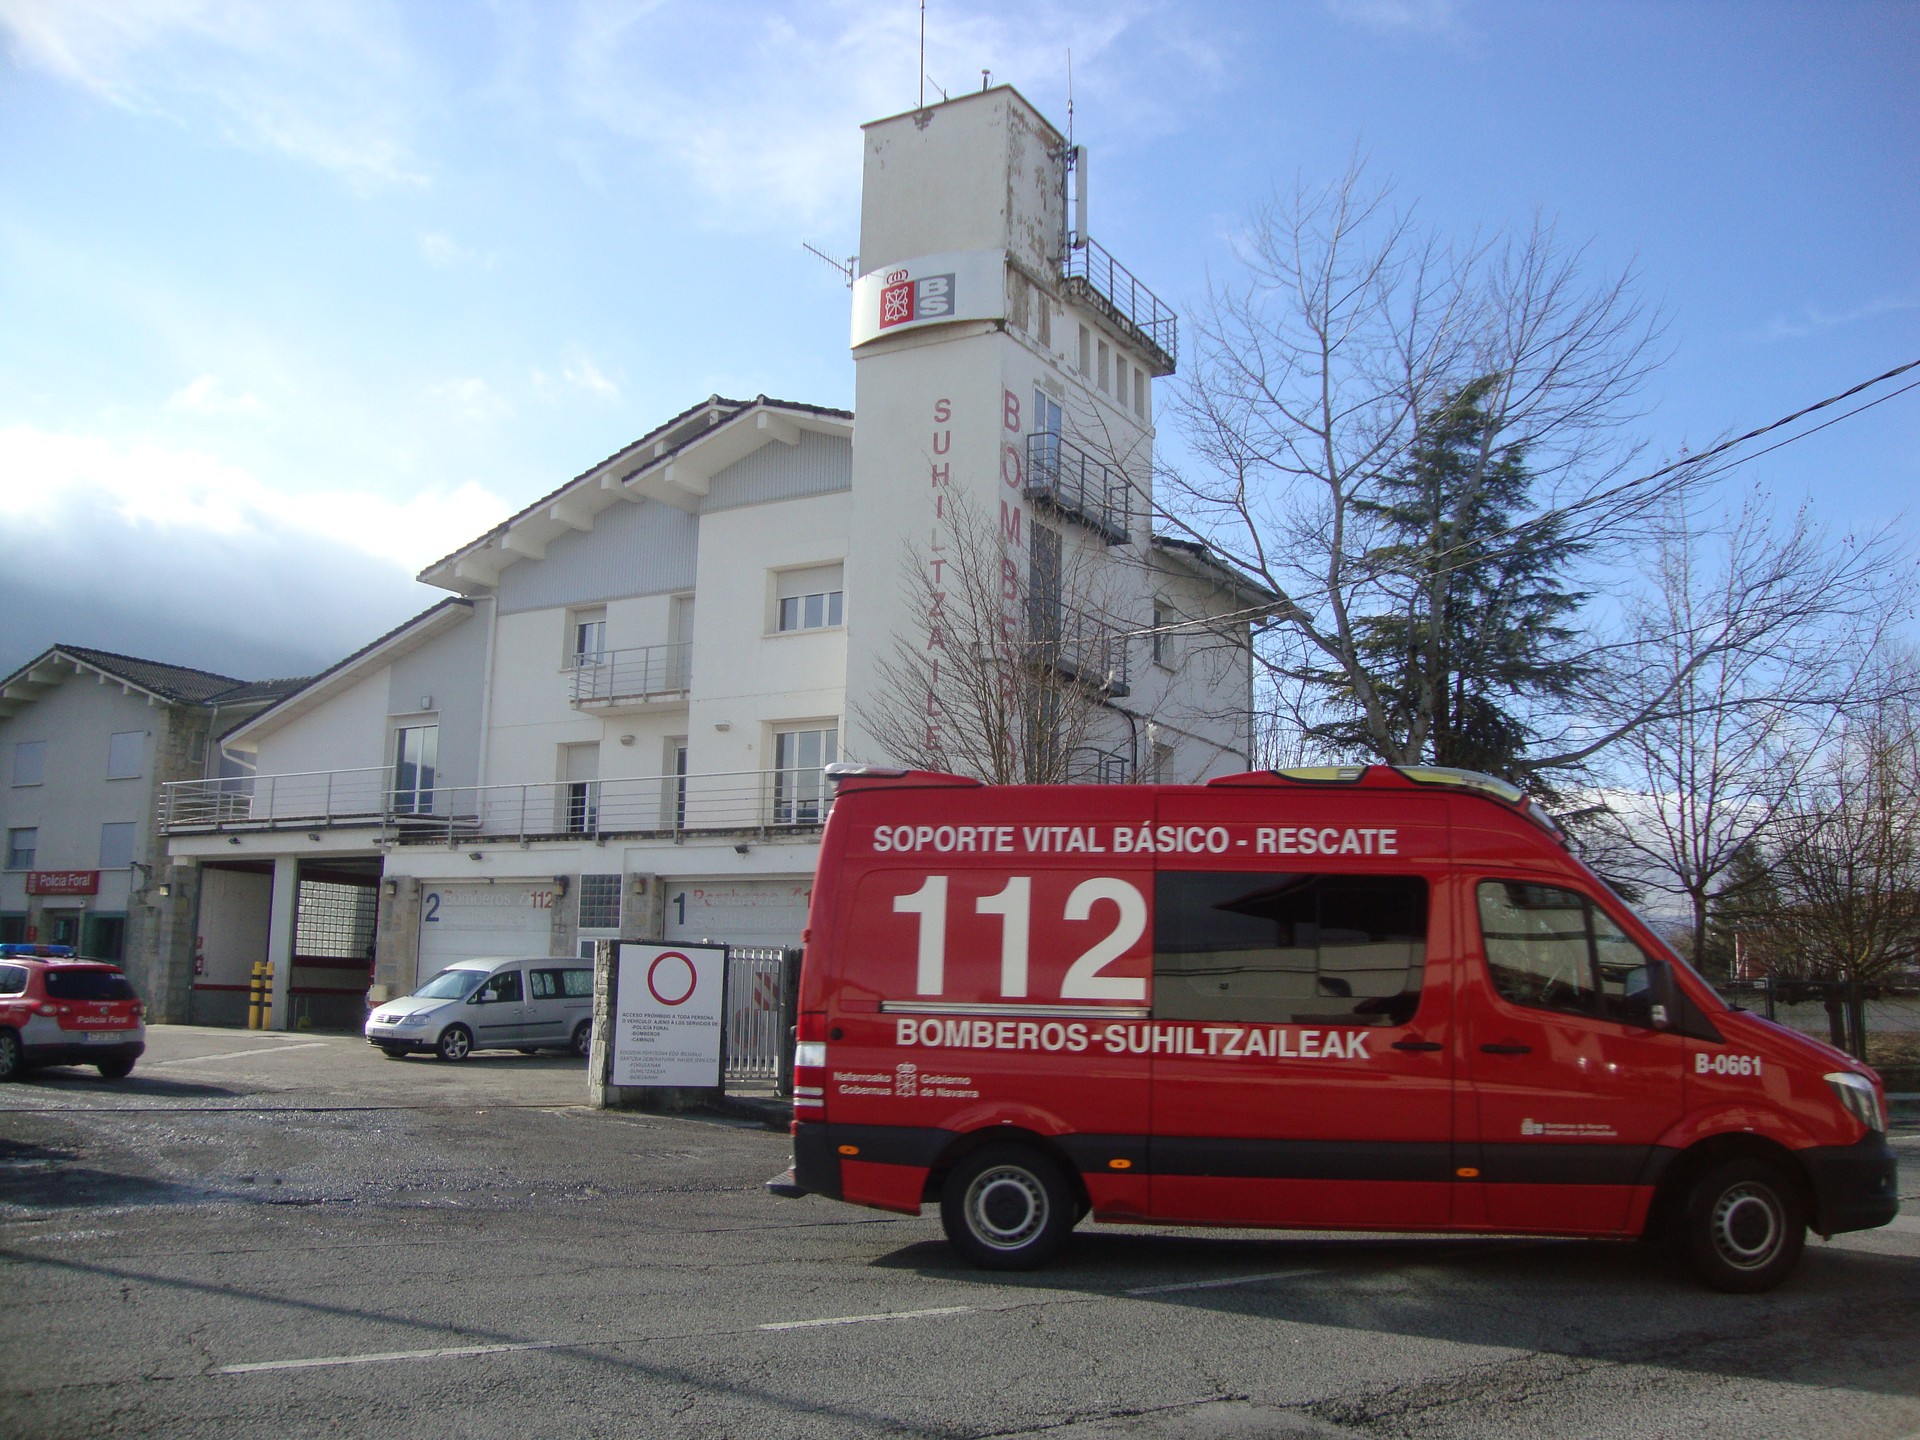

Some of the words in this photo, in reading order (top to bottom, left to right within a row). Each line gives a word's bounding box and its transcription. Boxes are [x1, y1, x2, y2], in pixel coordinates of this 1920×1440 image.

[920, 277, 949, 298] B
[919, 296, 949, 316] S
[873, 826, 1014, 852] SOPORTE
[1023, 826, 1105, 853] VITAL
[1113, 820, 1229, 854] BÁSICO
[1256, 828, 1398, 856] RESCATE
[68, 873, 90, 886] Foral
[425, 892, 440, 922] 2
[673, 892, 685, 925] 1
[893, 875, 1148, 1000] 112
[896, 1018, 1370, 1060] BOMBEROS-SUHILTZAILEAK
[1695, 1053, 1761, 1076] B-0661
[832, 1071, 892, 1083] Nafarroako
[920, 1074, 972, 1085] Gobierno
[838, 1084, 892, 1096] Gobernua
[920, 1087, 934, 1097] de
[936, 1088, 980, 1098] Navarra
